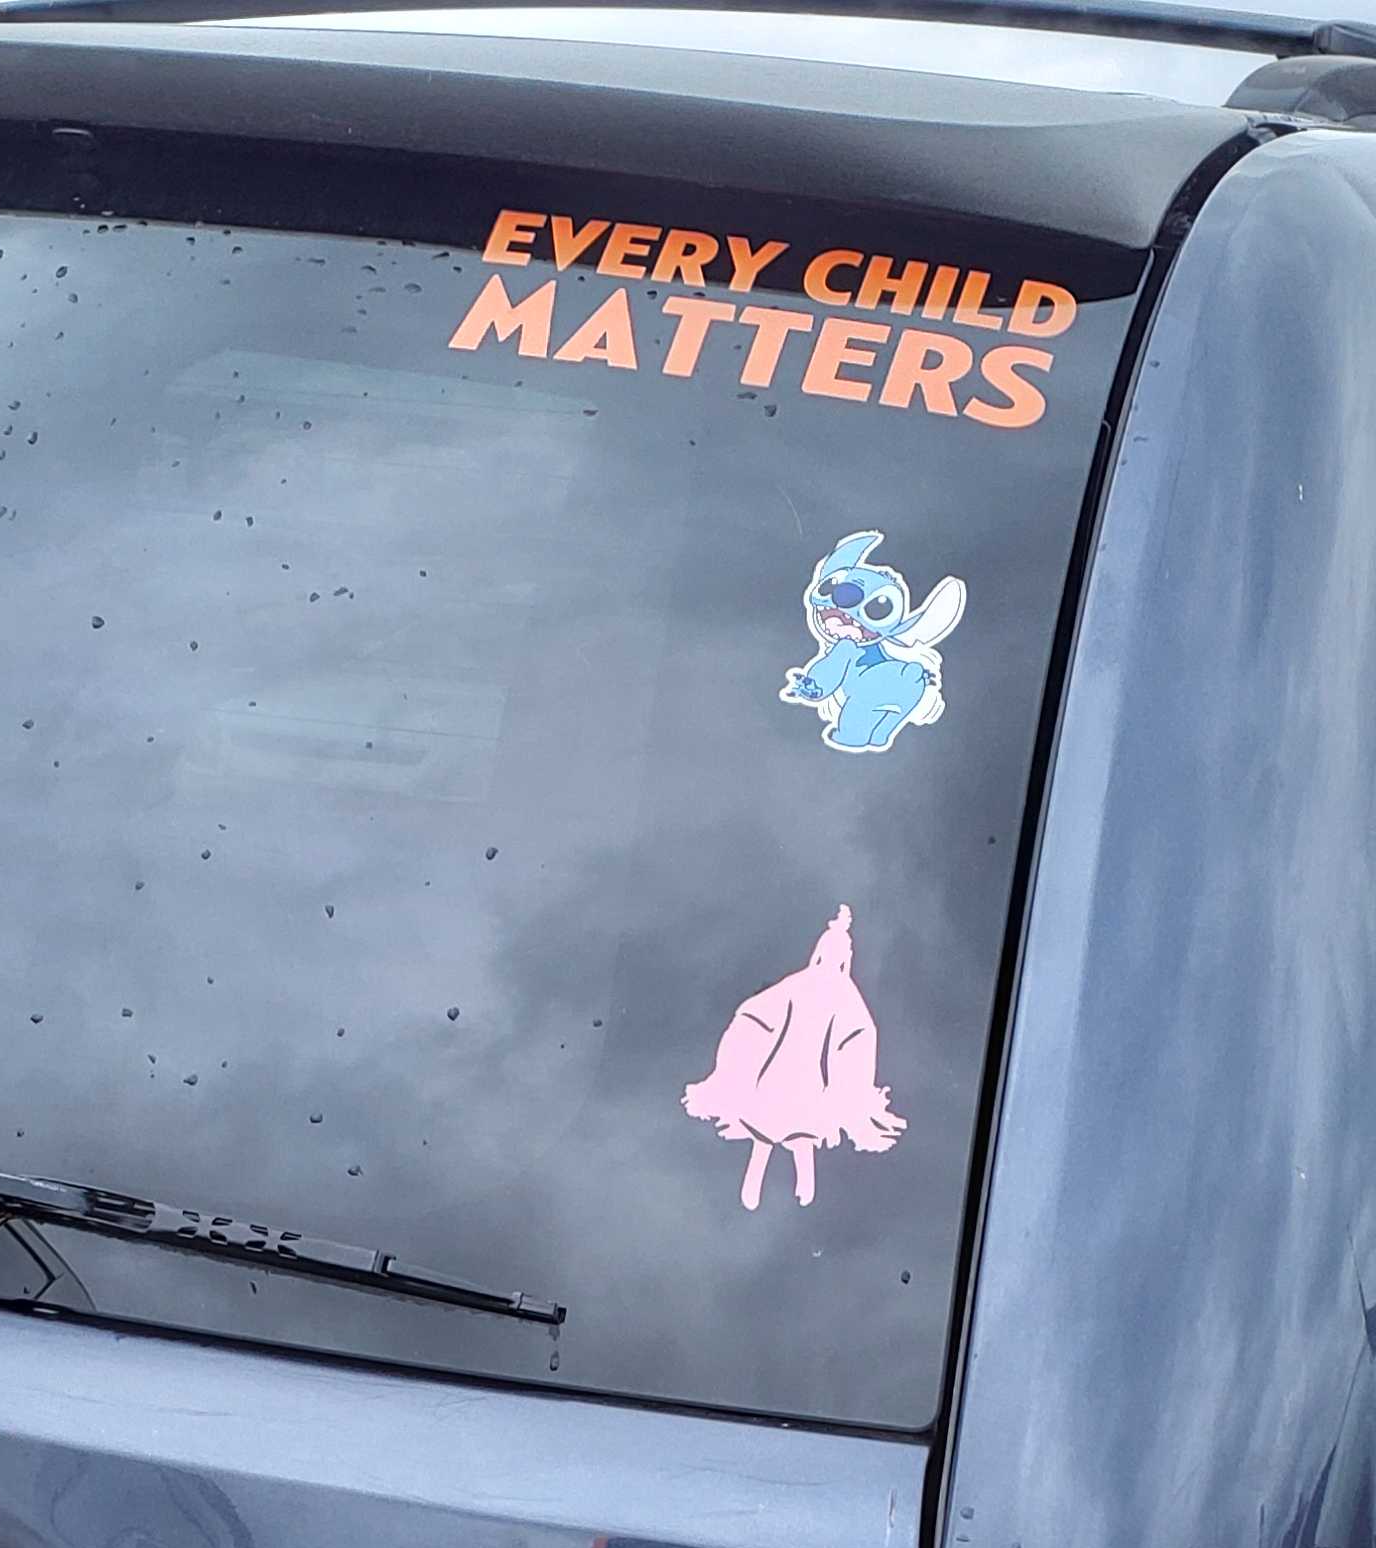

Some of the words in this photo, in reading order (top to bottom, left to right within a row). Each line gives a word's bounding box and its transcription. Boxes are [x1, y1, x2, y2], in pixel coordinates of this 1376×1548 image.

[483, 209, 790, 292] EVERY
[803, 249, 1078, 338] CHILD
[448, 274, 1055, 428] MATTERS
